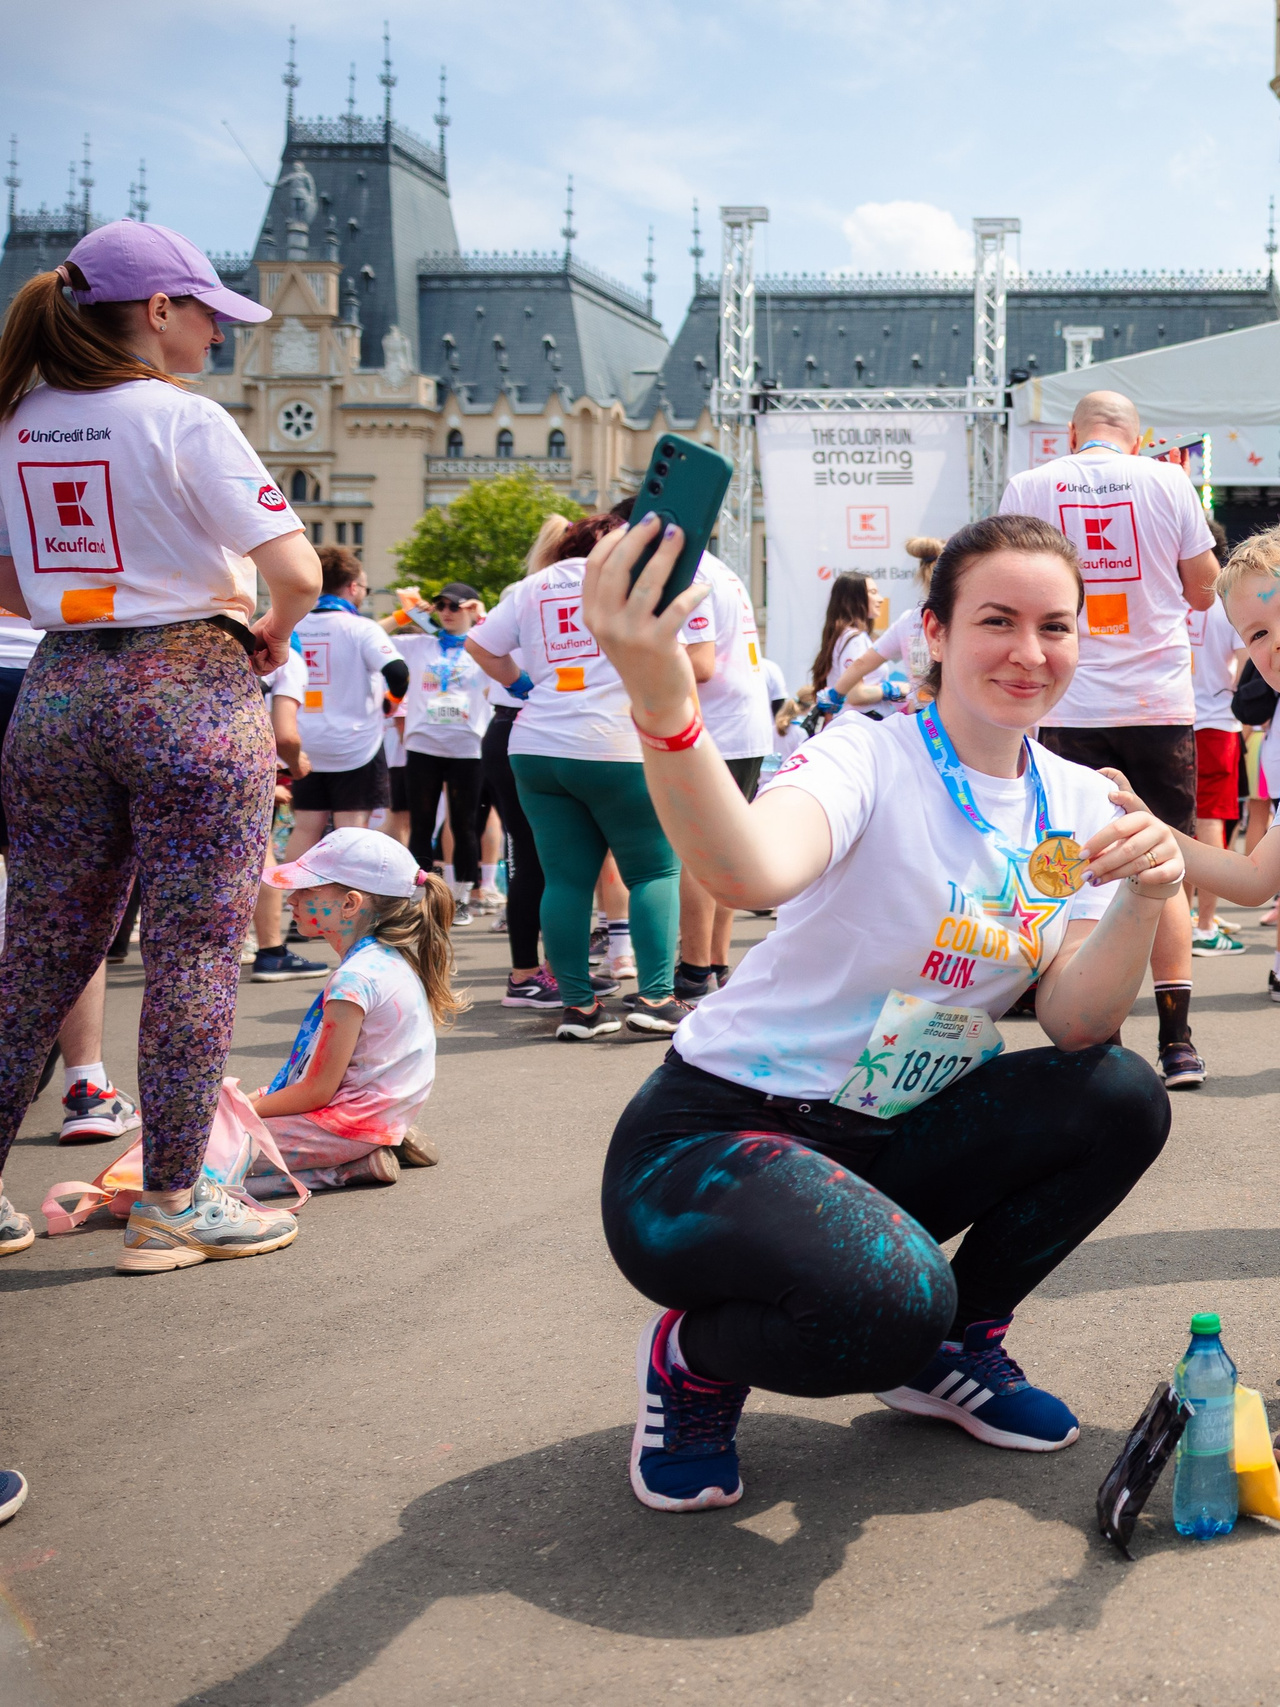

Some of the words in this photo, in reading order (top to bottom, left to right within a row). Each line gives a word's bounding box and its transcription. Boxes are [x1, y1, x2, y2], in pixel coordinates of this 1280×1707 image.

[31, 429, 84, 443] UniCredit
[86, 427, 112, 441] Bank
[812, 428, 834, 446] THE
[838, 428, 882, 446] COLOR
[812, 447, 913, 470] amazing
[829, 468, 873, 485] tour
[1067, 483, 1107, 495] UniCredit
[1109, 481, 1132, 493] Bank
[548, 581, 581, 590] UniCredit
[1090, 623, 1126, 634] orange
[550, 638, 592, 652] Kaufland
[935, 917, 1009, 961] COLOR
[929, 1020, 964, 1034] amazing
[929, 1028, 948, 1038] tour
[892, 1050, 973, 1093] 18127
